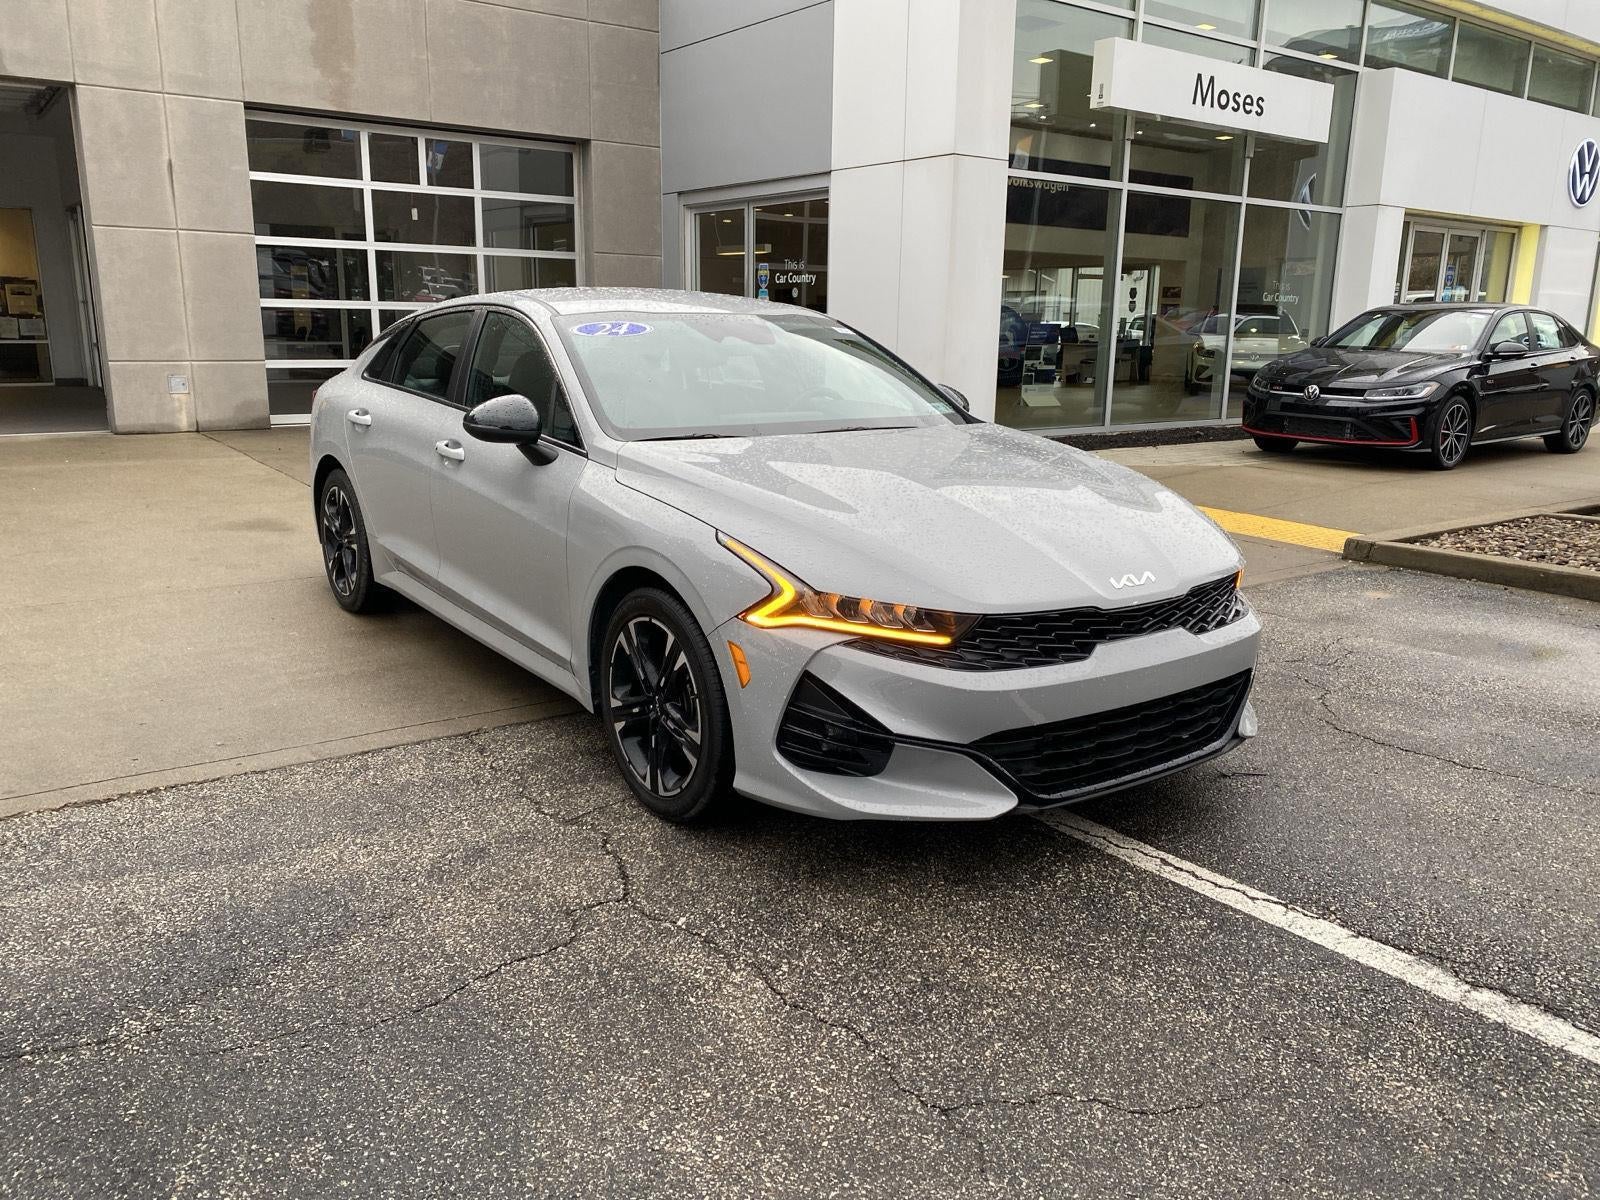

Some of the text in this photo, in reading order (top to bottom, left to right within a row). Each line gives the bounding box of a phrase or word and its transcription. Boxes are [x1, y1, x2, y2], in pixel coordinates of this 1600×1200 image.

[1192, 72, 1265, 117] Moses
[784, 258, 805, 270] This is
[774, 272, 816, 286] Car Country
[1262, 292, 1299, 305] Car Country
[592, 322, 629, 336] 24
